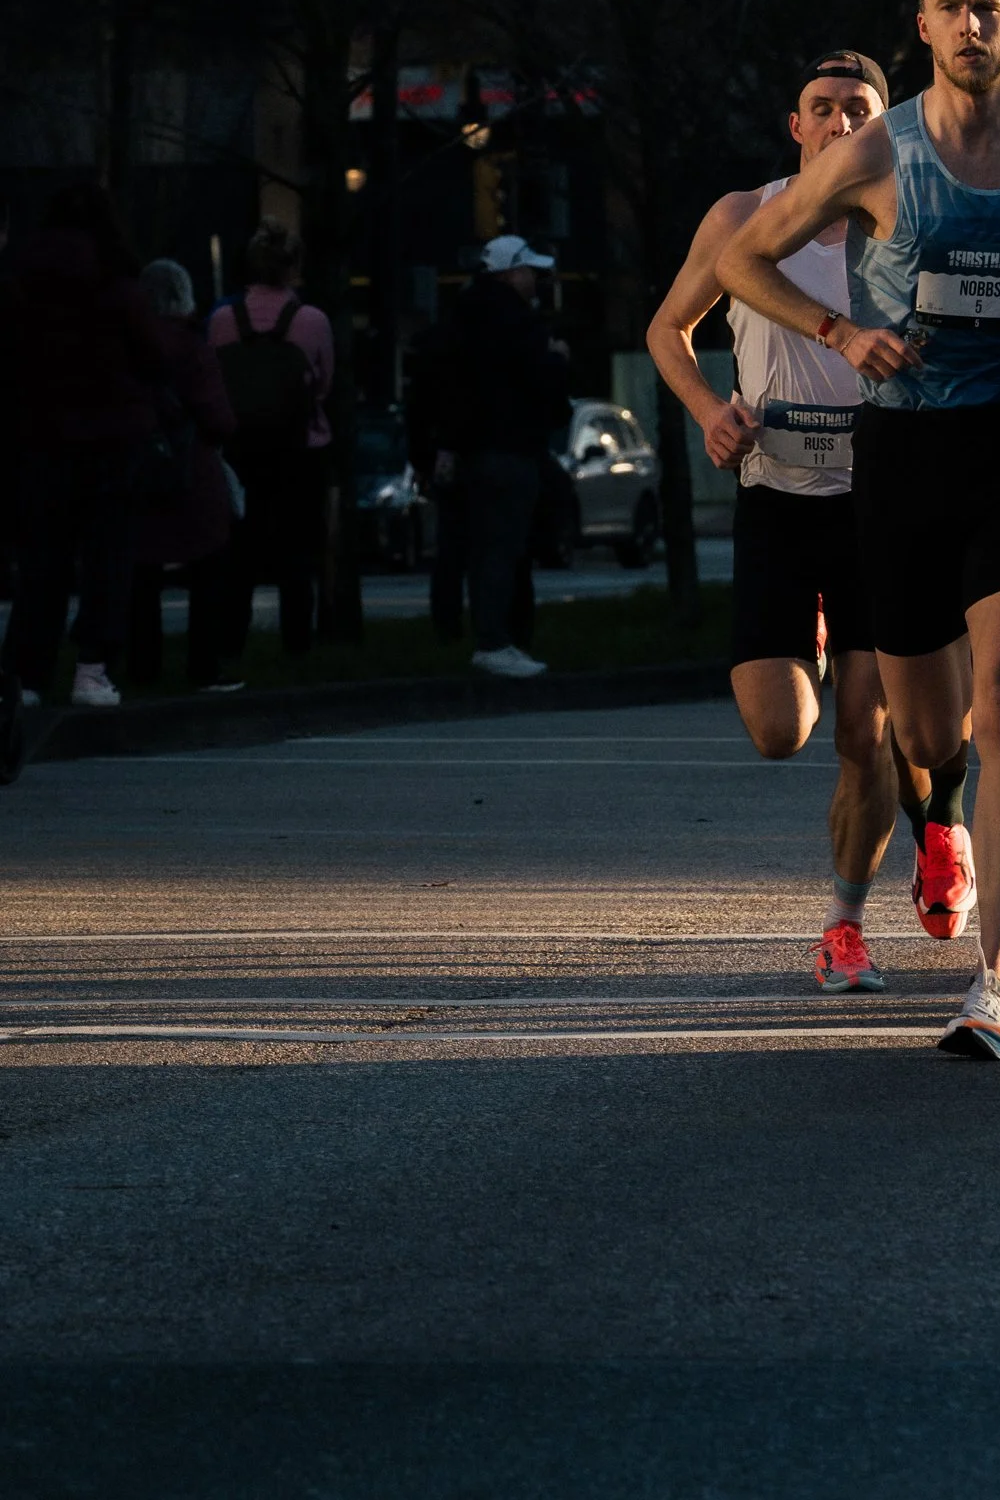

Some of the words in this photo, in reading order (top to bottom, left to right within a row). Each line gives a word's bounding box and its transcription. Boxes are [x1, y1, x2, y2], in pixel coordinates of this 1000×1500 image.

[960, 280, 1000, 297] NOBBS
[975, 300, 982, 314] 5
[804, 437, 834, 451] RUSS
[813, 453, 825, 465] 11
